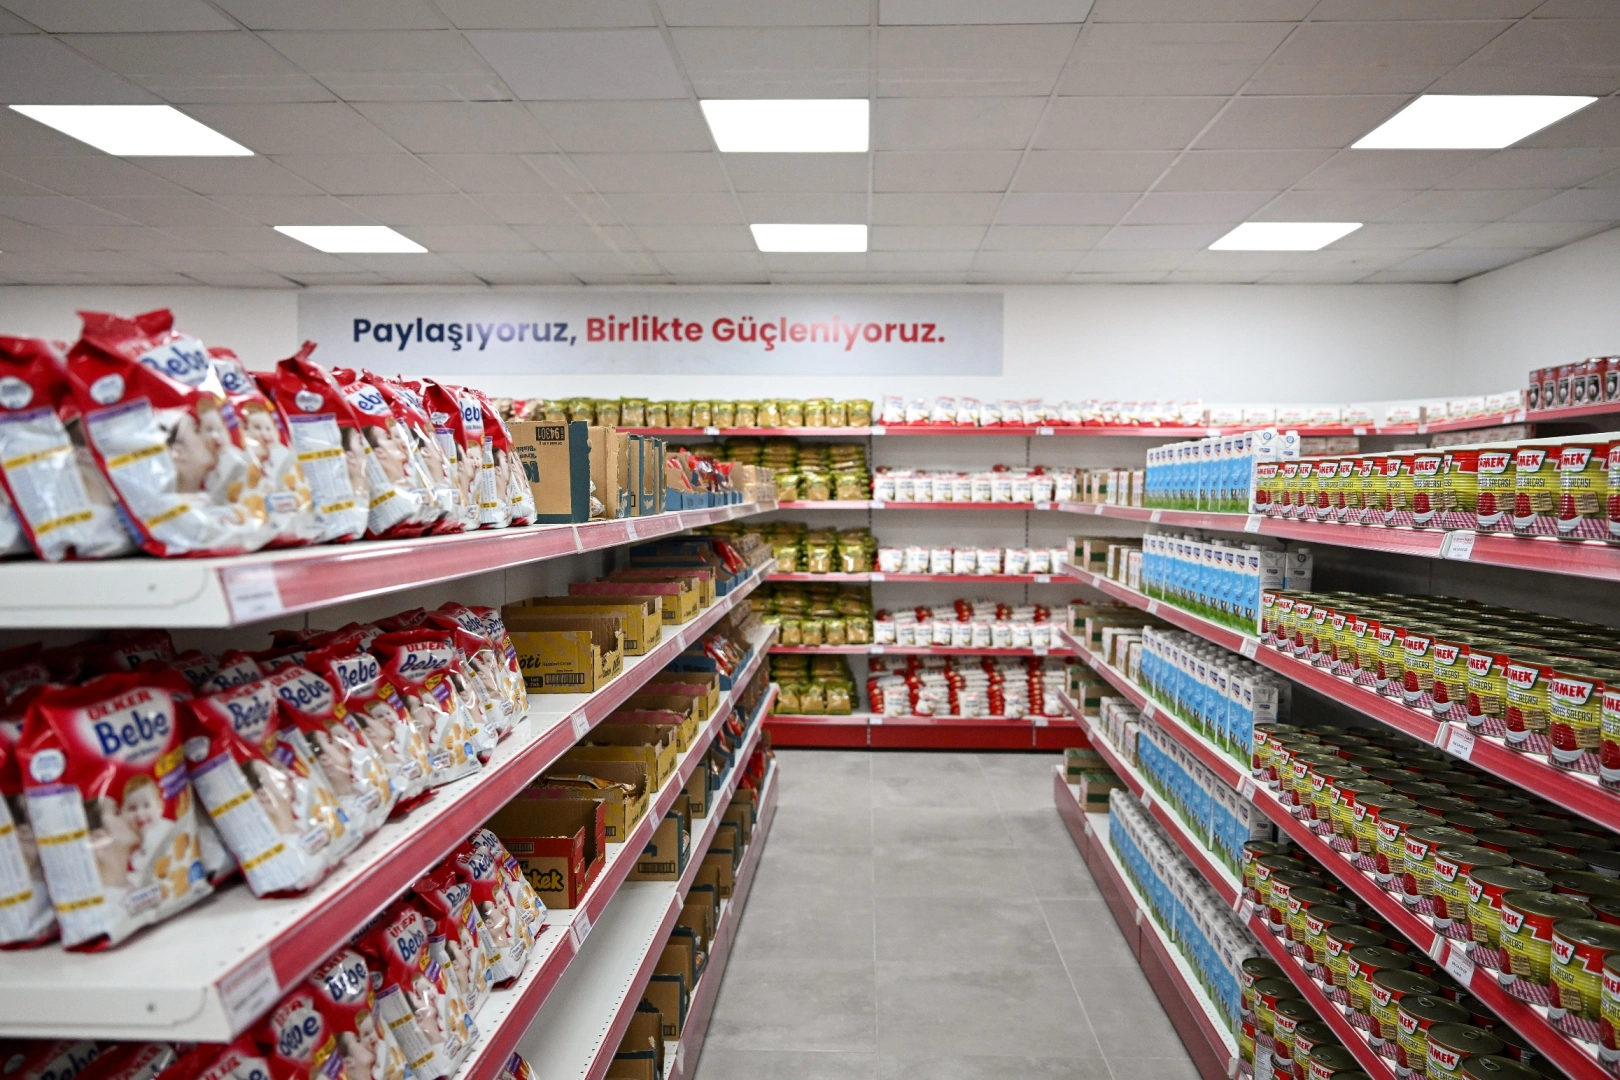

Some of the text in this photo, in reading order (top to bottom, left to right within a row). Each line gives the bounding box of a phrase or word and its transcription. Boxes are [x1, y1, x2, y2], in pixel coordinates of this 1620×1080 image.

[353, 316, 945, 351] Paylaşıyoruz, Birlikte Güçleniyoruz.
[337, 658, 378, 689] Bebe
[400, 653, 448, 673] Bebe
[519, 653, 541, 669] öti
[279, 678, 330, 709] Bebe
[94, 709, 169, 756] Bebe
